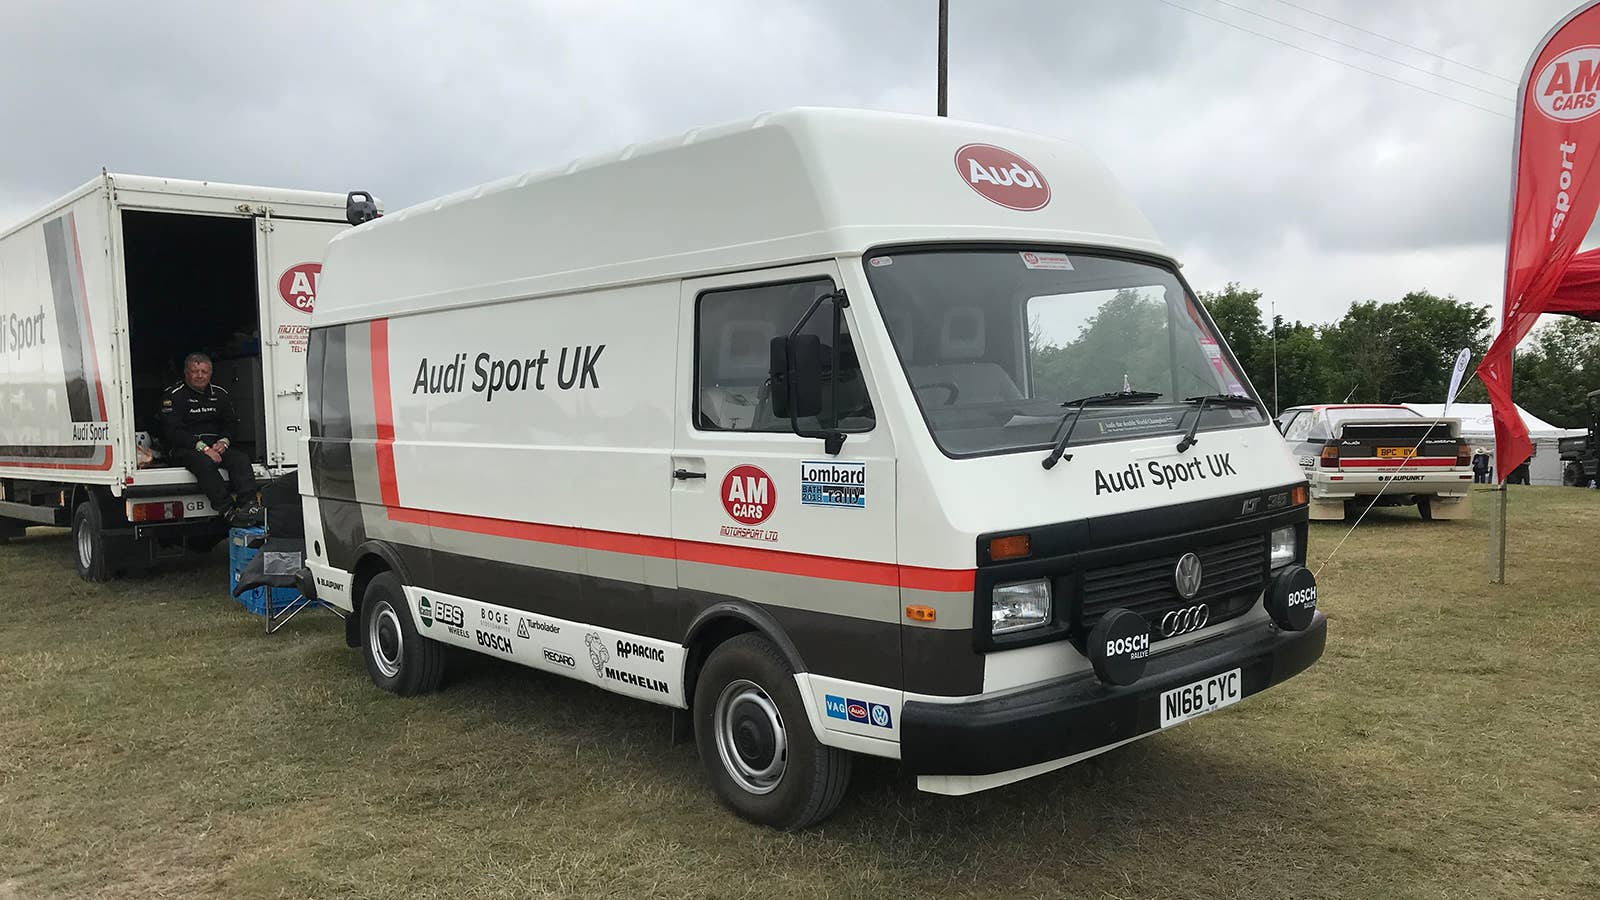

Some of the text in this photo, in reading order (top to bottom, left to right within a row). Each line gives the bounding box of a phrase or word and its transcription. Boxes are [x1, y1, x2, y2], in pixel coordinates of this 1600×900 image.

[1544, 59, 1600, 96] AM
[1552, 93, 1597, 111] CARS
[967, 158, 1043, 189] Audi
[10, 304, 46, 361] Sport
[412, 344, 606, 402] Audi Sport UK
[73, 423, 109, 445] Audi Sport
[801, 464, 865, 484] Lombard
[1095, 453, 1237, 495] Audi Sport UK
[728, 475, 768, 505] AM
[802, 485, 862, 504] BATH rally
[802, 493, 822, 502] 2018
[186, 501, 204, 511] GB
[733, 503, 763, 519] CARS
[720, 525, 764, 540] MOTORSPORT
[1288, 585, 1316, 607] BOSCH
[435, 601, 464, 628] BBS
[481, 608, 508, 625] BOGE
[448, 626, 470, 638] WHEELS
[527, 618, 560, 634] Turbolader
[476, 629, 513, 654] BOSCH
[1106, 633, 1149, 657] BOSCH
[543, 650, 575, 667] RECARO
[632, 643, 664, 663] RACING
[1130, 650, 1149, 660] RALLYE
[605, 667, 669, 694] MICHELIN
[1166, 672, 1237, 721] N166 CYC
[827, 701, 845, 713] VAG
[851, 707, 865, 715] Audi
